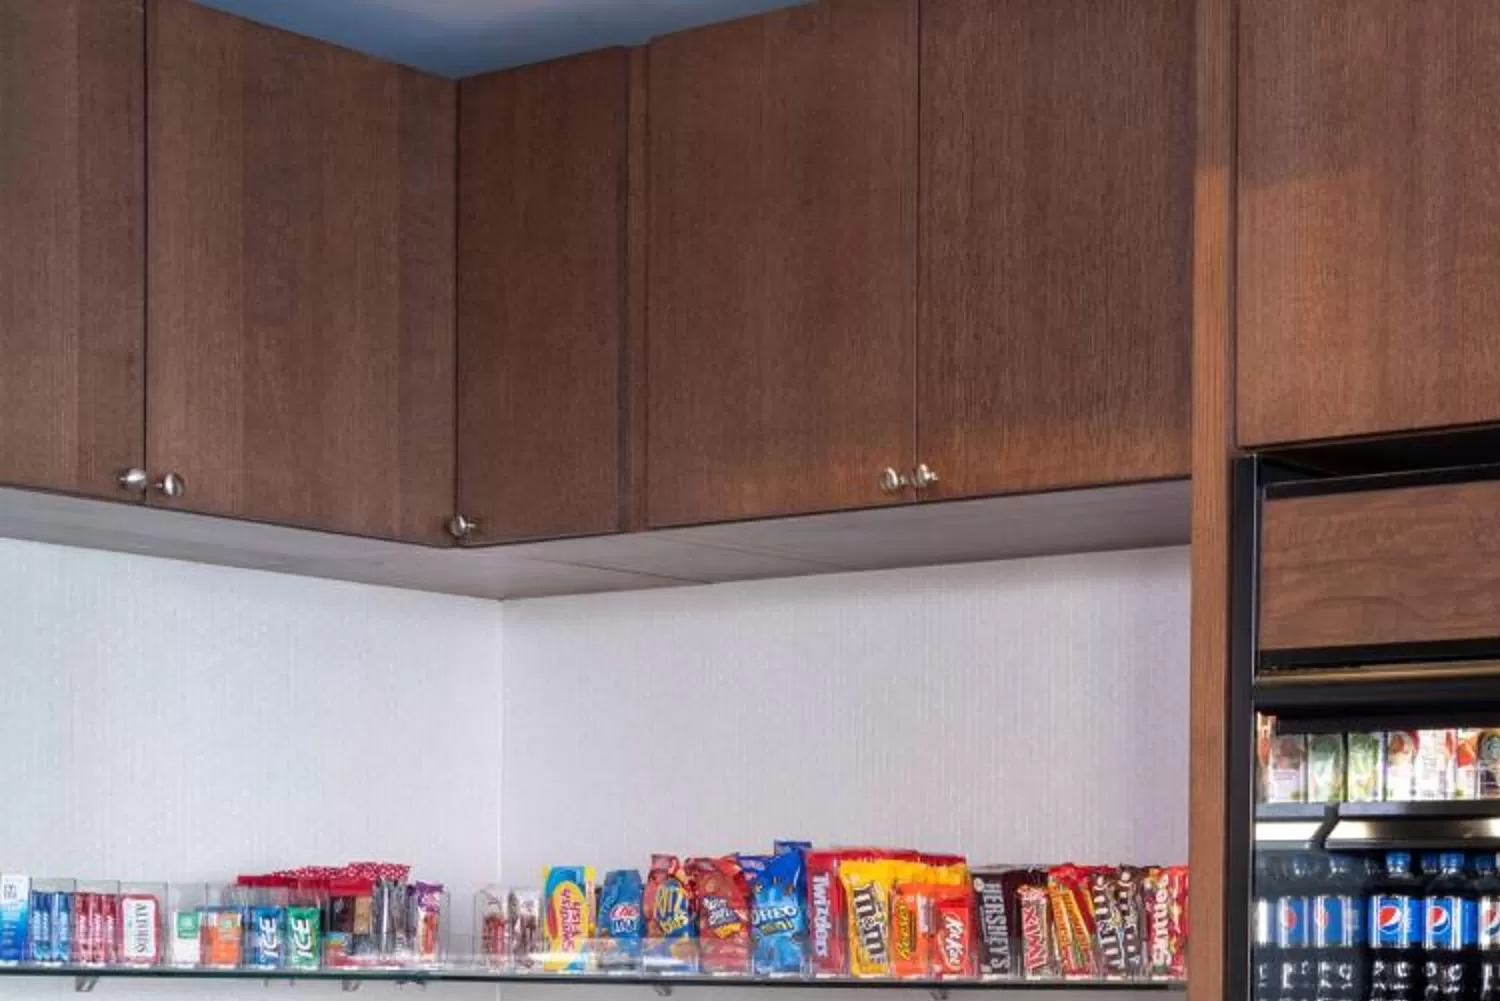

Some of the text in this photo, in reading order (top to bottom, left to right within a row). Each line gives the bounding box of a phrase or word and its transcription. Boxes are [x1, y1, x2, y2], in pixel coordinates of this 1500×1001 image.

[136, 903, 149, 953] ALTOIDS
[259, 917, 279, 957] ICE
[291, 917, 314, 957] ICE
[982, 881, 1011, 969] HERSHEY'S
